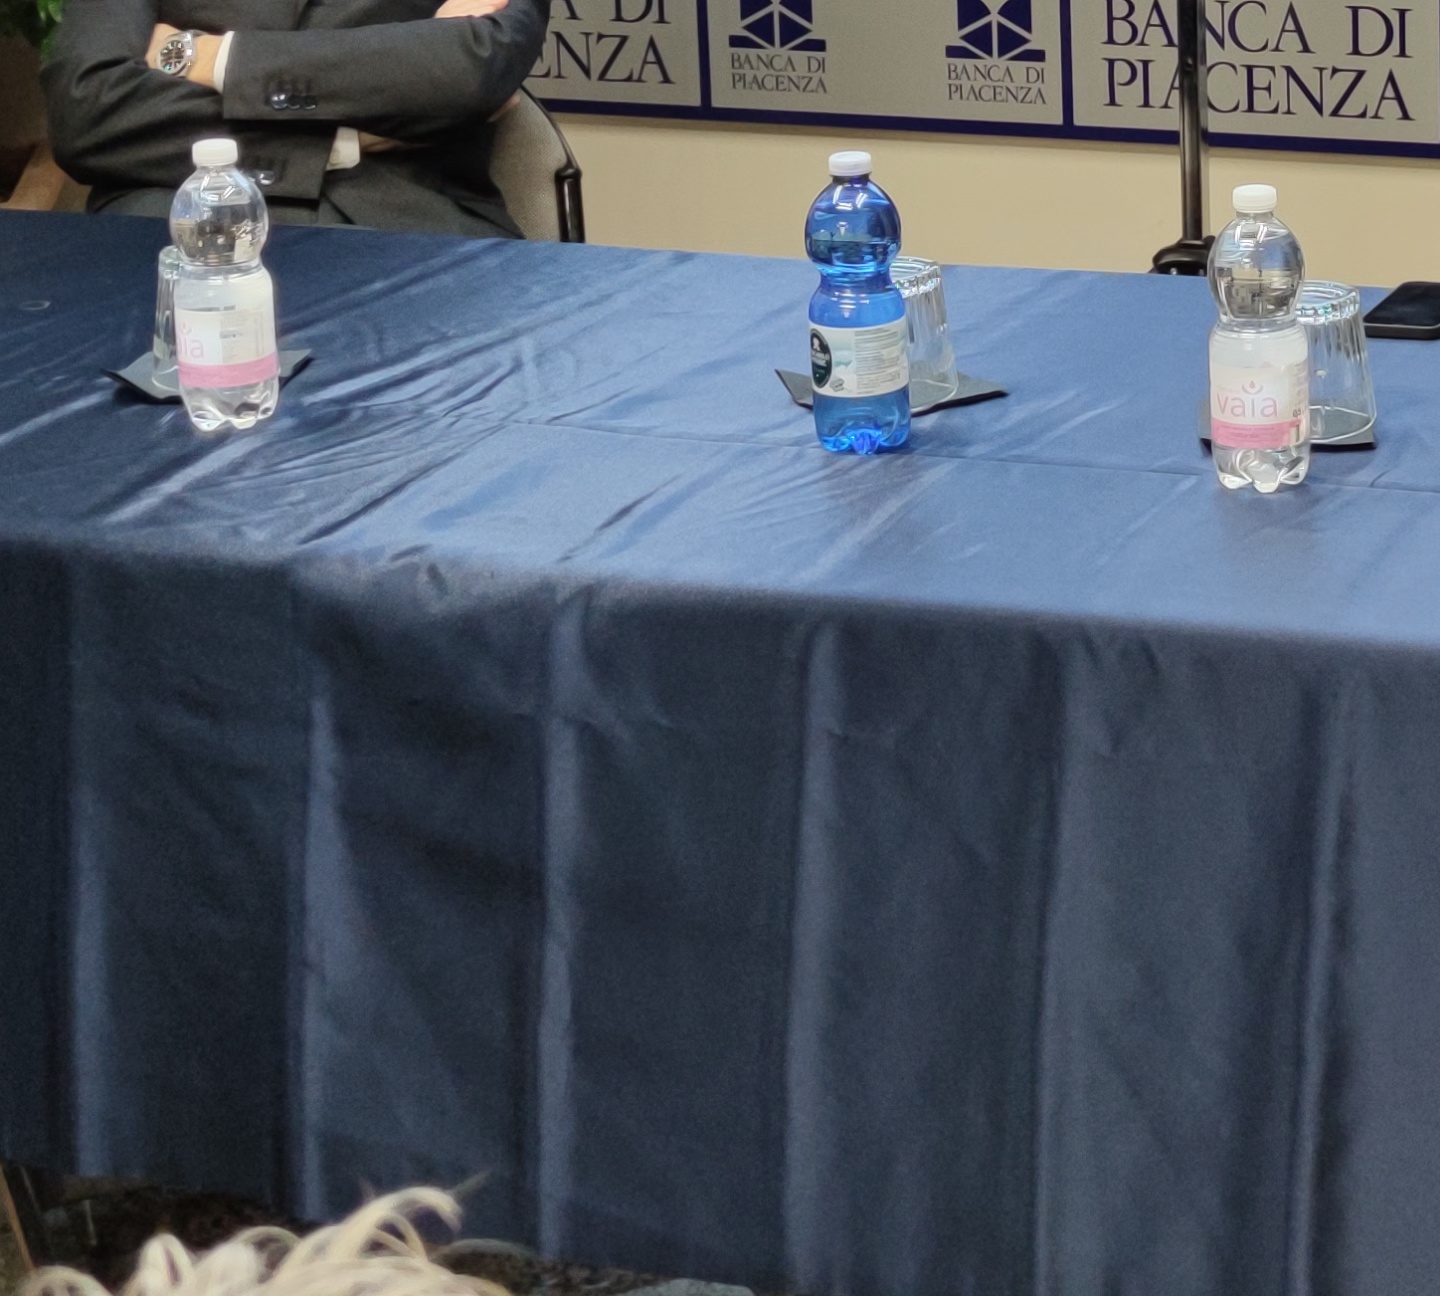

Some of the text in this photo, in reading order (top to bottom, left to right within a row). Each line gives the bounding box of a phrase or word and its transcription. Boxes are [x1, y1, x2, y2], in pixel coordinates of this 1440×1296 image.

[1345, 5, 1413, 58] DI
[731, 52, 827, 73] BANCA DI
[946, 62, 1046, 84] BANCA DI
[731, 72, 828, 94] PIACENZA
[948, 82, 1047, 105] PIACENZA
[1217, 393, 1278, 418] vaia
